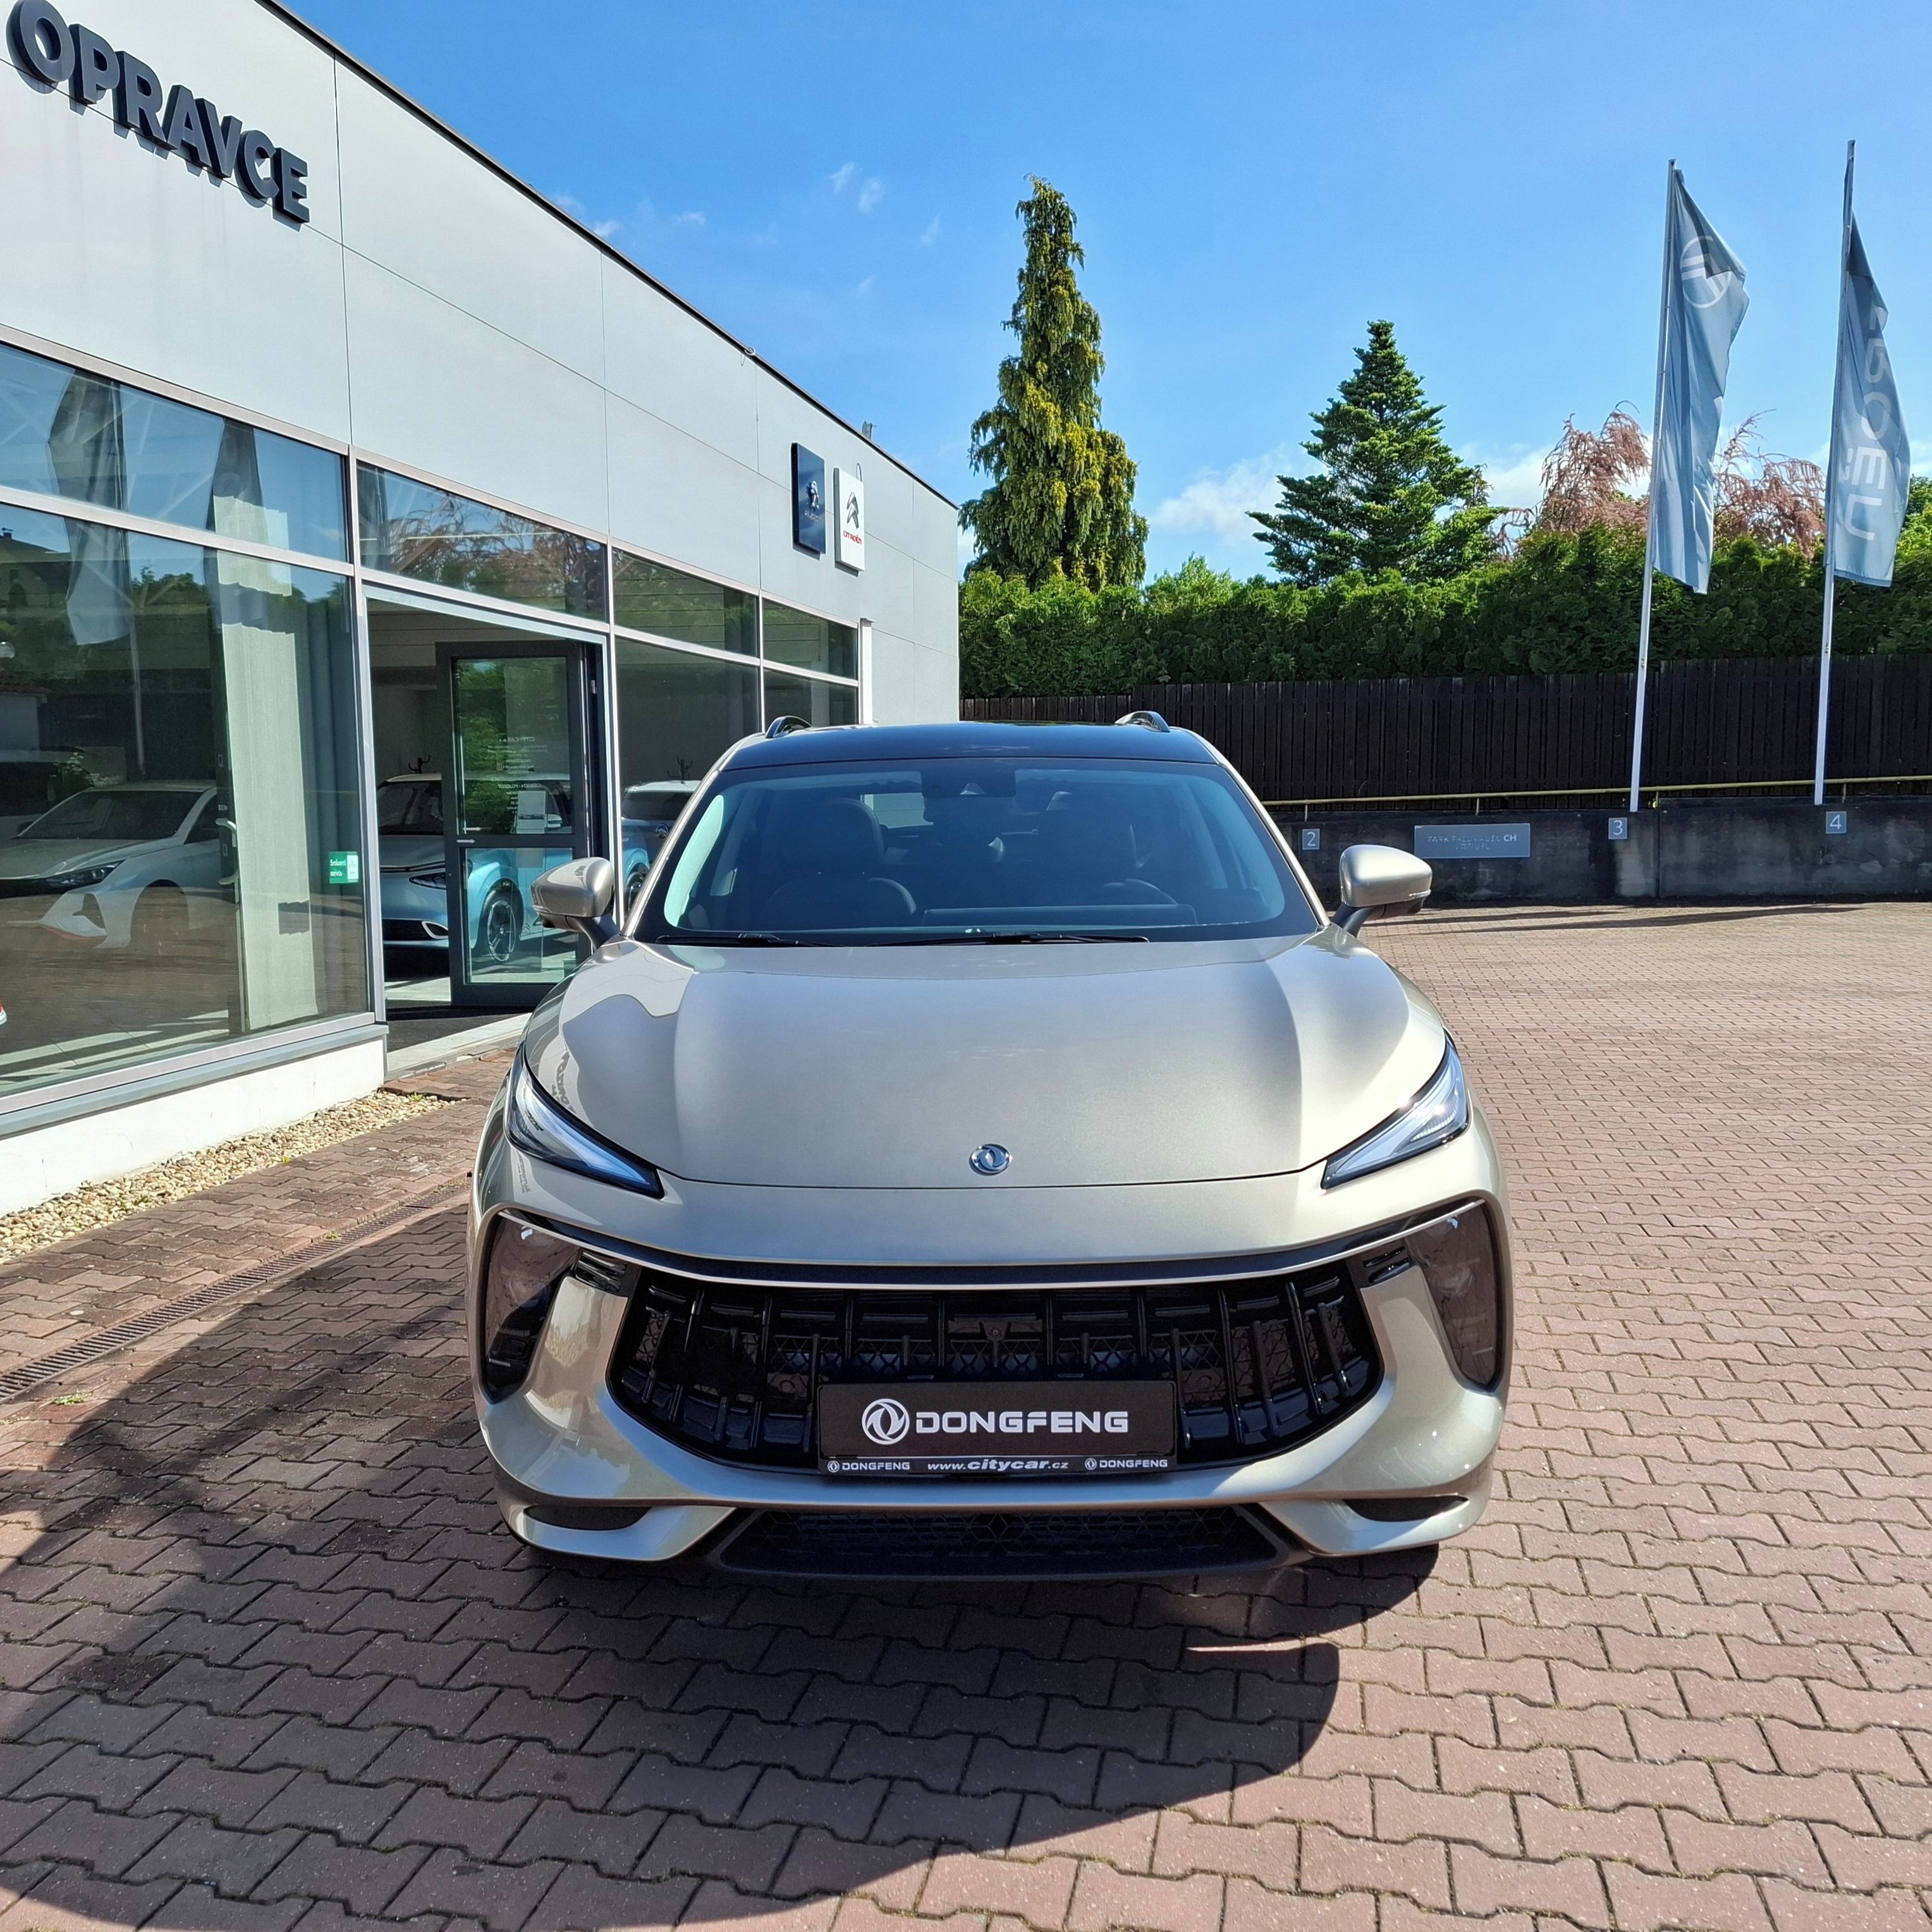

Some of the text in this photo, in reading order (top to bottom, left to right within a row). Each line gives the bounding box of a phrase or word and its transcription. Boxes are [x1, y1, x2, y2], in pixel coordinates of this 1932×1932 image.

[6, 0, 310, 224] OPRAVCE
[1612, 820, 1623, 835] 3
[1829, 814, 1842, 829] 4
[1307, 831, 1316, 847] 2
[915, 1411, 1128, 1434] DONGFENG
[841, 1462, 910, 1471] DONGFENG
[927, 1458, 1069, 1472] www.citycar.cz
[1099, 1459, 1168, 1469] DONGFENG
